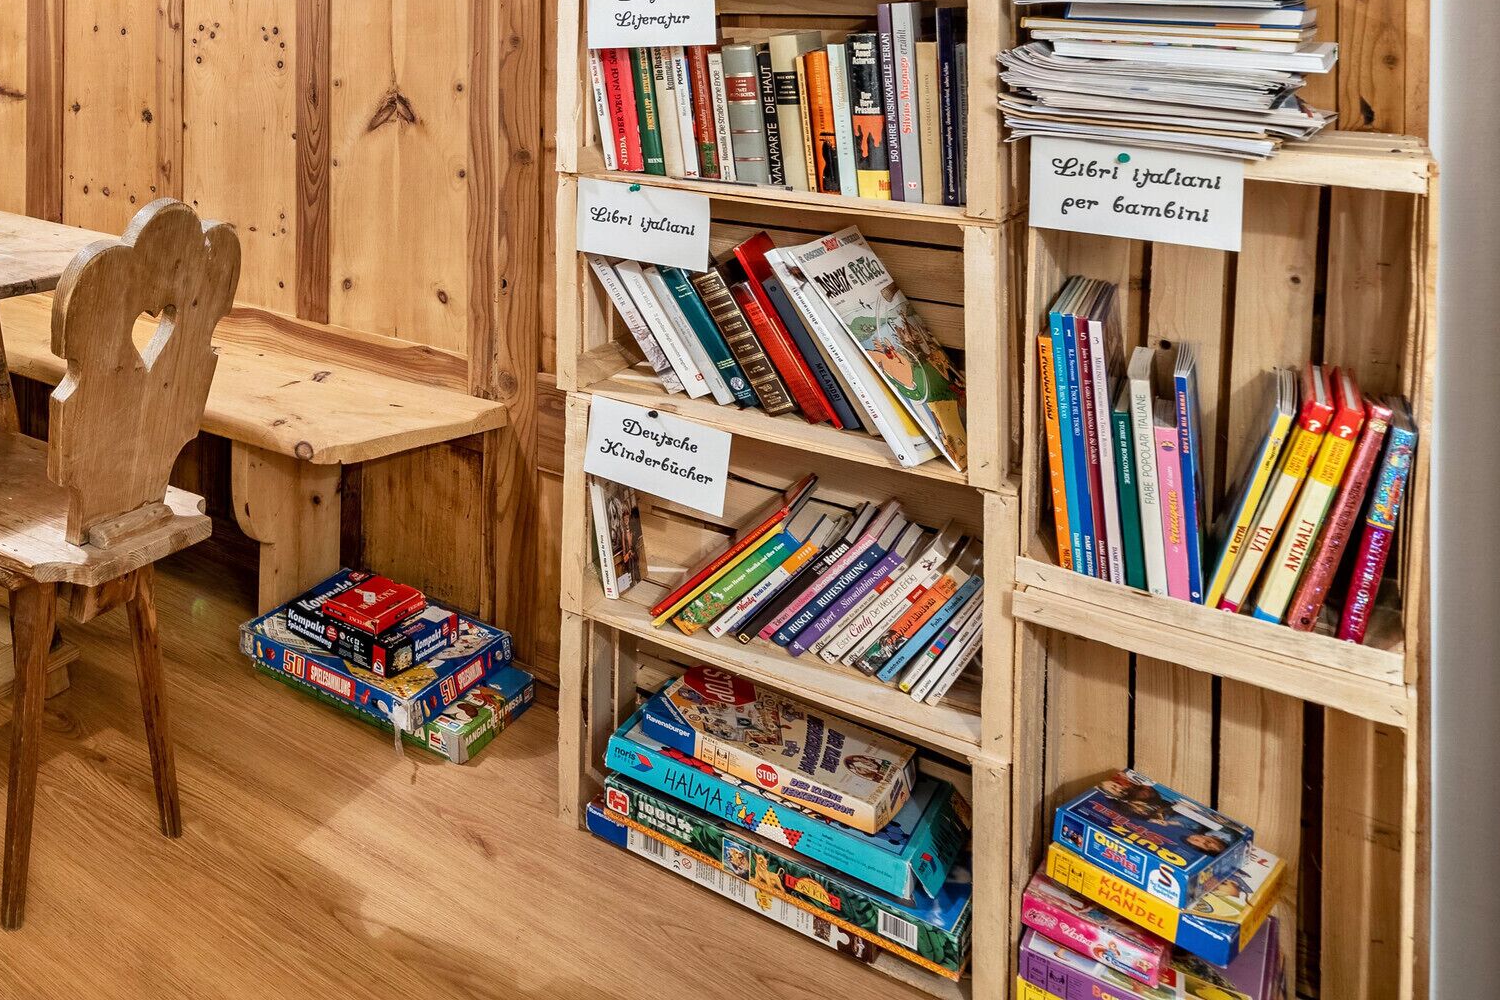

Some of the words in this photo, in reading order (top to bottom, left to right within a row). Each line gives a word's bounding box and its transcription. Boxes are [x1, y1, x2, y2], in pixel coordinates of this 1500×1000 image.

[615, 11, 690, 29] Literatur
[881, 32, 890, 62] TERLAN
[611, 67, 620, 90] NACH
[655, 68, 663, 81] Die
[663, 60, 675, 91] kommen
[675, 58, 683, 84] PORSCHE
[712, 70, 720, 86] Ende
[761, 64, 773, 93] HAUT
[898, 56, 909, 100] Magnago
[614, 94, 622, 113] WEG
[714, 86, 722, 103] ohne
[764, 96, 775, 113] DIE
[860, 92, 871, 100] Der
[883, 64, 895, 121] MUSIKKAPELLE
[716, 104, 724, 123] Straße
[854, 106, 880, 115] Präsident
[901, 102, 912, 134] Silvius
[616, 115, 625, 133] DER
[718, 124, 726, 135] Die
[888, 123, 897, 148] JAHRE
[619, 135, 629, 165] NIDDA
[719, 135, 728, 161] Konsalik
[766, 122, 782, 185] MALAPARTE
[890, 149, 898, 162] 150
[1052, 158, 1119, 179] Libri
[1133, 168, 1221, 190] italiani
[591, 207, 632, 225] Libri
[641, 217, 695, 235] italiani
[1061, 197, 1099, 214] per
[1113, 196, 1209, 222] bambini
[591, 257, 608, 277] LILLI
[604, 276, 628, 306] GRUBER
[791, 286, 819, 326] abbinamenti
[828, 343, 843, 363] piatti
[1080, 347, 1088, 358] Jules
[814, 361, 841, 402] MELANDRI
[863, 399, 878, 419] Birra
[1071, 405, 1079, 415] DEL
[1086, 411, 1094, 427] MONDO
[1135, 393, 1148, 429] ITALIANE
[622, 419, 698, 453] Deutsche
[1072, 416, 1081, 435] TESORO
[1118, 420, 1126, 440] STORIE
[1089, 445, 1097, 464] GIORNI
[1120, 440, 1127, 448] DI
[1139, 433, 1152, 477] POPOLARI
[600, 438, 713, 485] Kinderbücher
[1121, 448, 1130, 484] BOSCOVERDE
[1142, 481, 1154, 504] FIABE
[1166, 489, 1182, 545] Principessa
[1072, 531, 1080, 546] DAMI
[1231, 523, 1247, 544] CITTÀ
[1249, 524, 1273, 554] VITA
[1283, 518, 1315, 572] ANIMALI
[823, 541, 849, 566] Katzen
[1228, 544, 1239, 553] LA
[812, 538, 873, 593] Ich-mag-dich-Geschichten
[734, 593, 756, 614] Wendy
[752, 587, 764, 598] Pferde
[787, 609, 813, 633] RUSCH
[816, 558, 869, 608] RUHESTÖRUNG
[814, 610, 837, 632] Talbert
[839, 563, 888, 609] Simsalabim-Sam
[846, 612, 874, 639] Cindy
[868, 604, 882, 618] Der
[877, 595, 894, 611] Weg
[889, 586, 904, 600] zum
[899, 572, 918, 590] Erfolg
[288, 608, 325, 634] Kompakt
[930, 615, 943, 628] Fuchs
[944, 593, 963, 613] Friederike
[287, 620, 332, 649] Spielesammlung
[415, 628, 441, 650] Kompakt
[814, 639, 825, 650] dtv
[415, 638, 448, 661] Spielesammlung
[847, 650, 859, 662] dtv
[283, 649, 306, 679] 50
[310, 668, 351, 697] SPIELESAMMLUNG
[440, 676, 457, 705] 50
[458, 659, 484, 690] SPIELESAMMLUNG
[702, 668, 736, 705] STOP
[503, 694, 525, 713] PASSA
[646, 713, 690, 738] Ravensburger
[615, 746, 636, 760] noris
[757, 768, 778, 783] STOP
[664, 767, 723, 811] HALMA
[781, 786, 855, 816] VERKEHRSPROFI
[790, 778, 810, 791] DER
[811, 784, 843, 802] KLEINE
[638, 812, 693, 844] PUZZLE
[1094, 831, 1129, 855] Quiz
[1108, 824, 1187, 867] QUIZ
[1100, 875, 1148, 905] KUH-
[1098, 887, 1165, 930] HANDEL
[1181, 915, 1224, 941] Ravensburger
